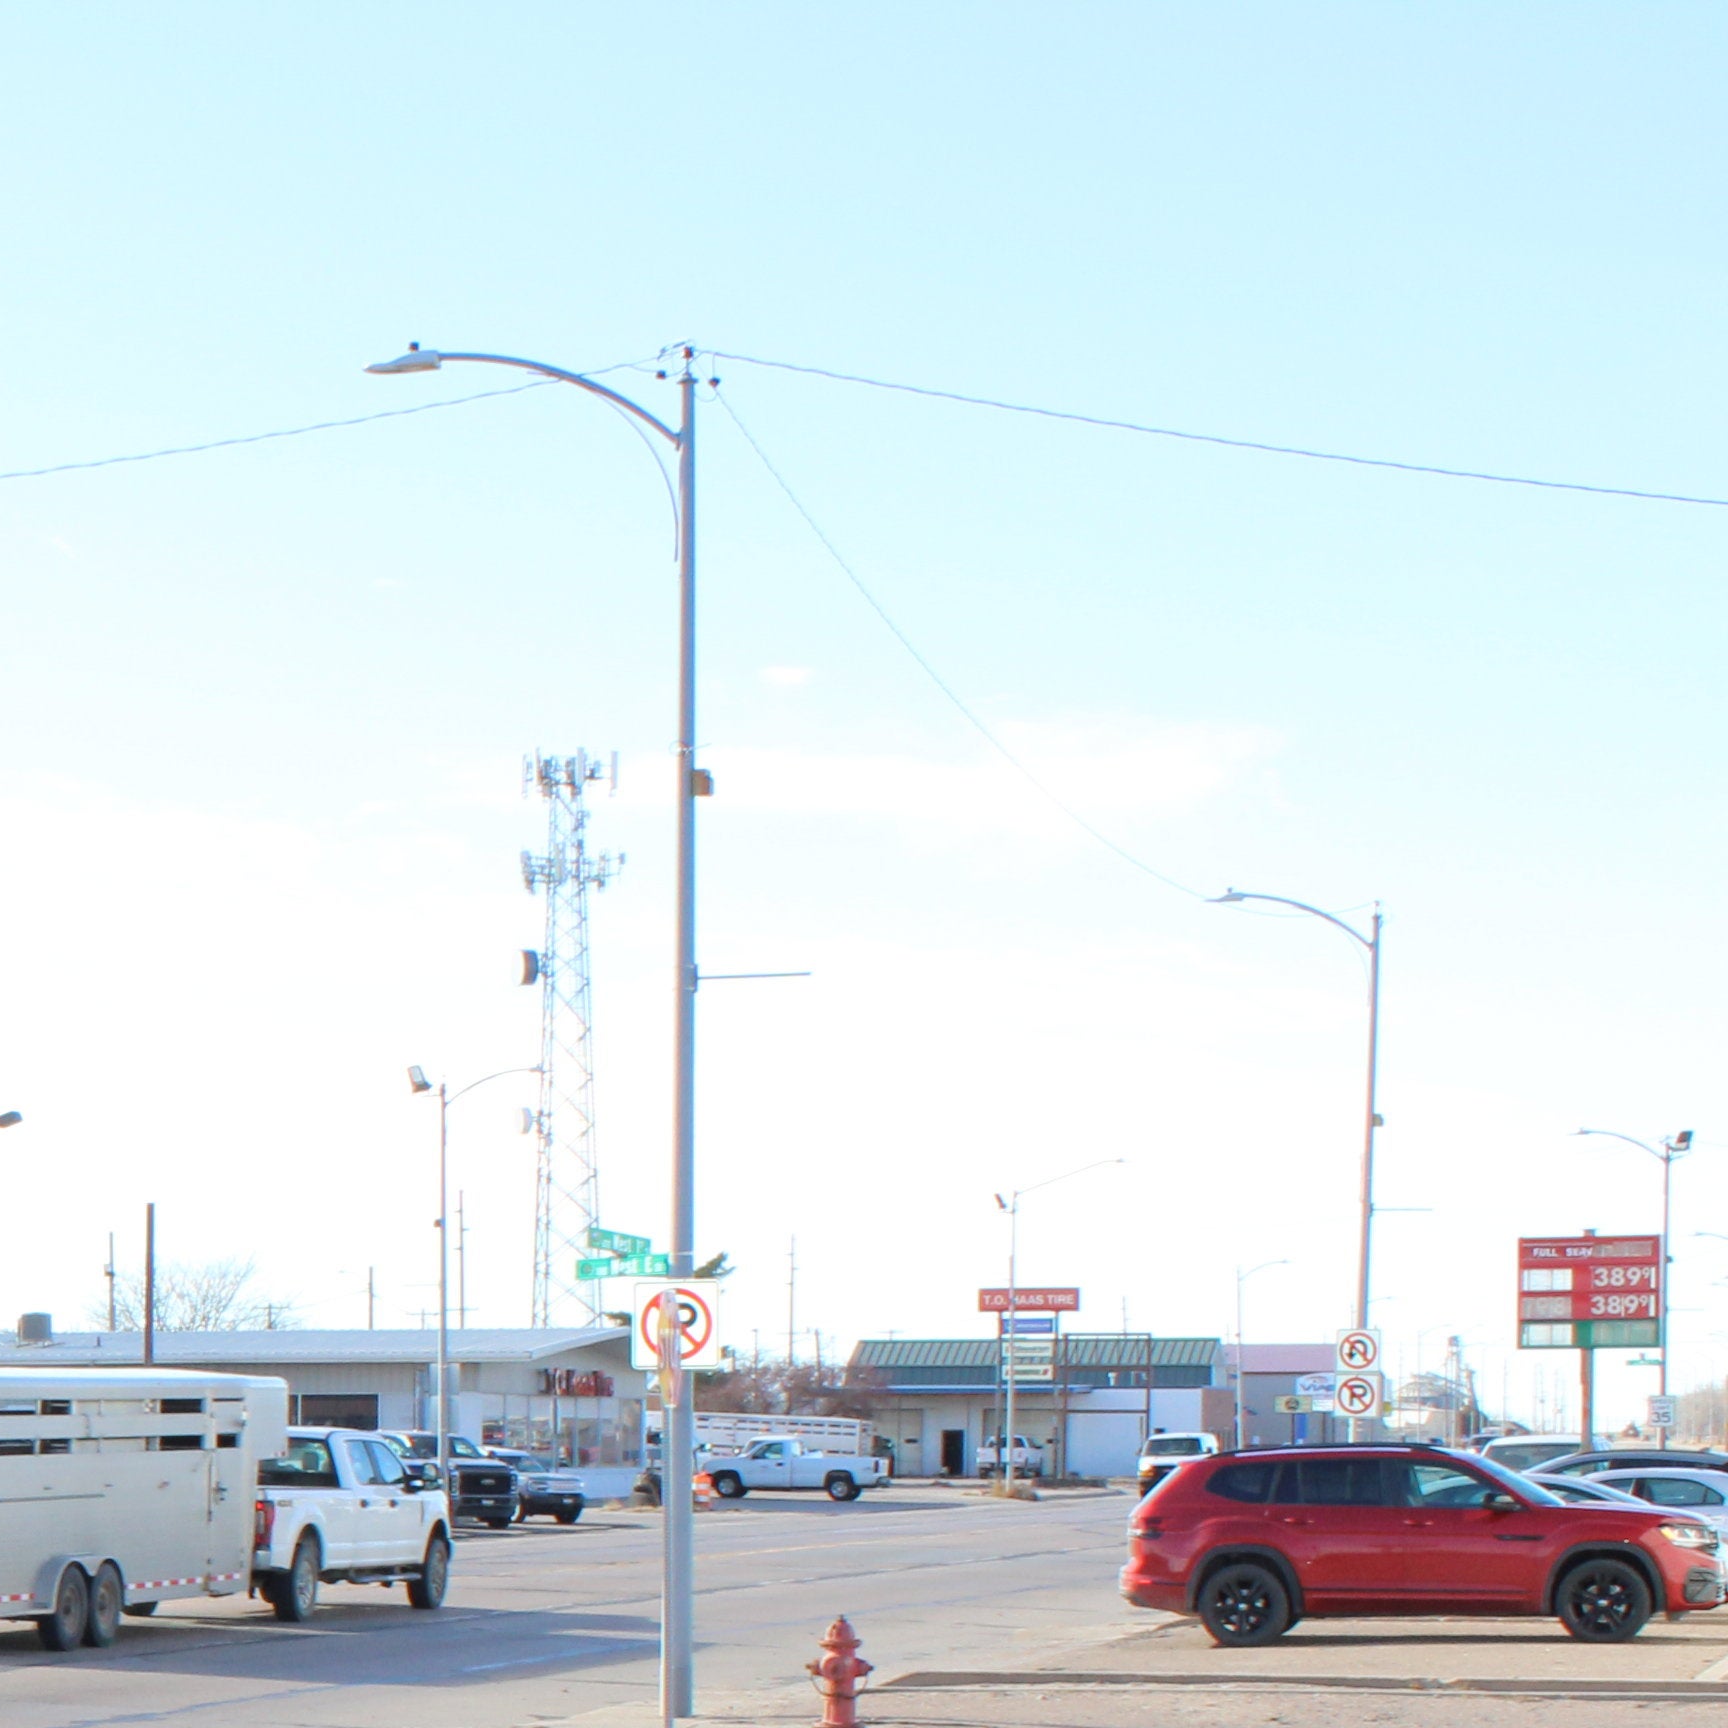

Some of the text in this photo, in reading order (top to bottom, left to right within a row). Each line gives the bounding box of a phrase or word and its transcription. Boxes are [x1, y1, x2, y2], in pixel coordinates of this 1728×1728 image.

[1532, 1247, 1558, 1258] FULL
[983, 1294, 1007, 1306] T.O.
[1046, 1294, 1075, 1305] TIRE
[1651, 1411, 1672, 1423] 35
